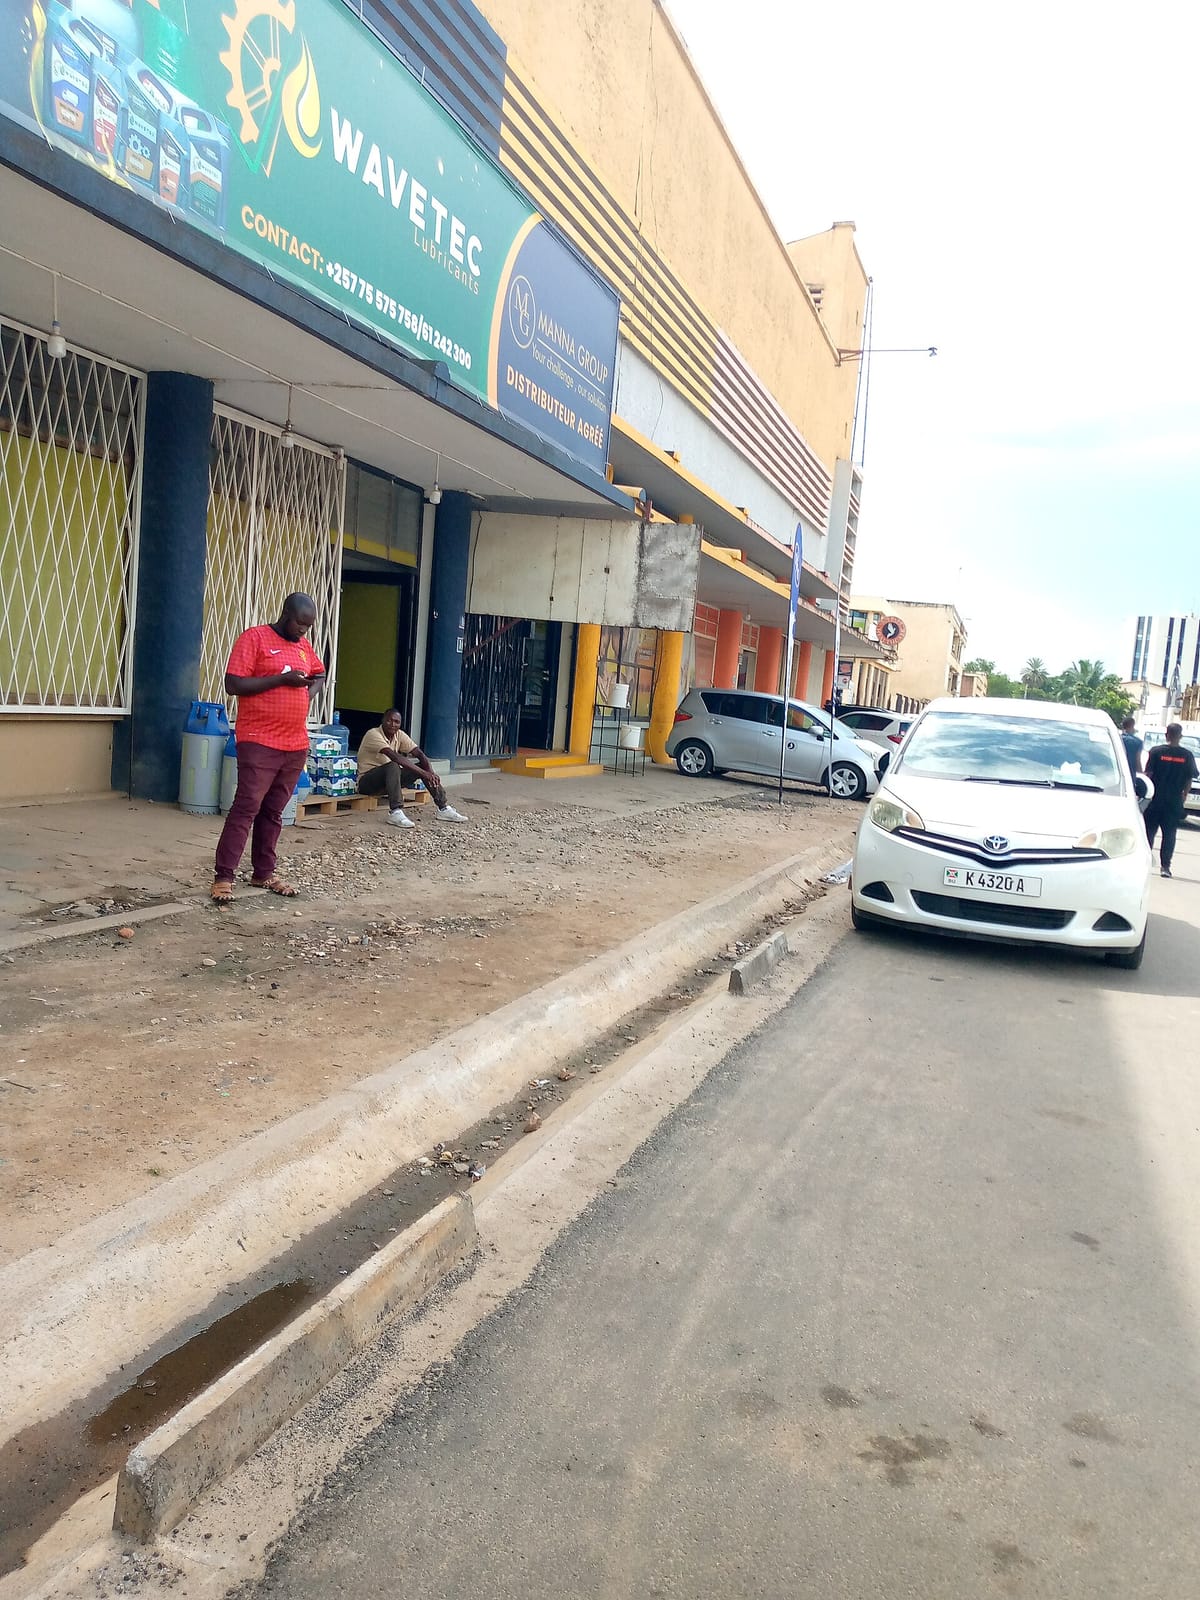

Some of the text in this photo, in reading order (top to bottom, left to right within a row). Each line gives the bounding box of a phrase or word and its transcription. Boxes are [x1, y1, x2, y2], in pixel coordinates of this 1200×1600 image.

[330, 106, 484, 277] WAVETEC
[241, 205, 324, 274] CONTACT:
[414, 227, 480, 296] Lubricants
[531, 343, 548, 366] Your
[538, 311, 608, 385] MANNA GROUP
[507, 364, 604, 448] DISTRIBUTEUR AGRÉÉ
[965, 871, 1025, 892] K 4320 A
